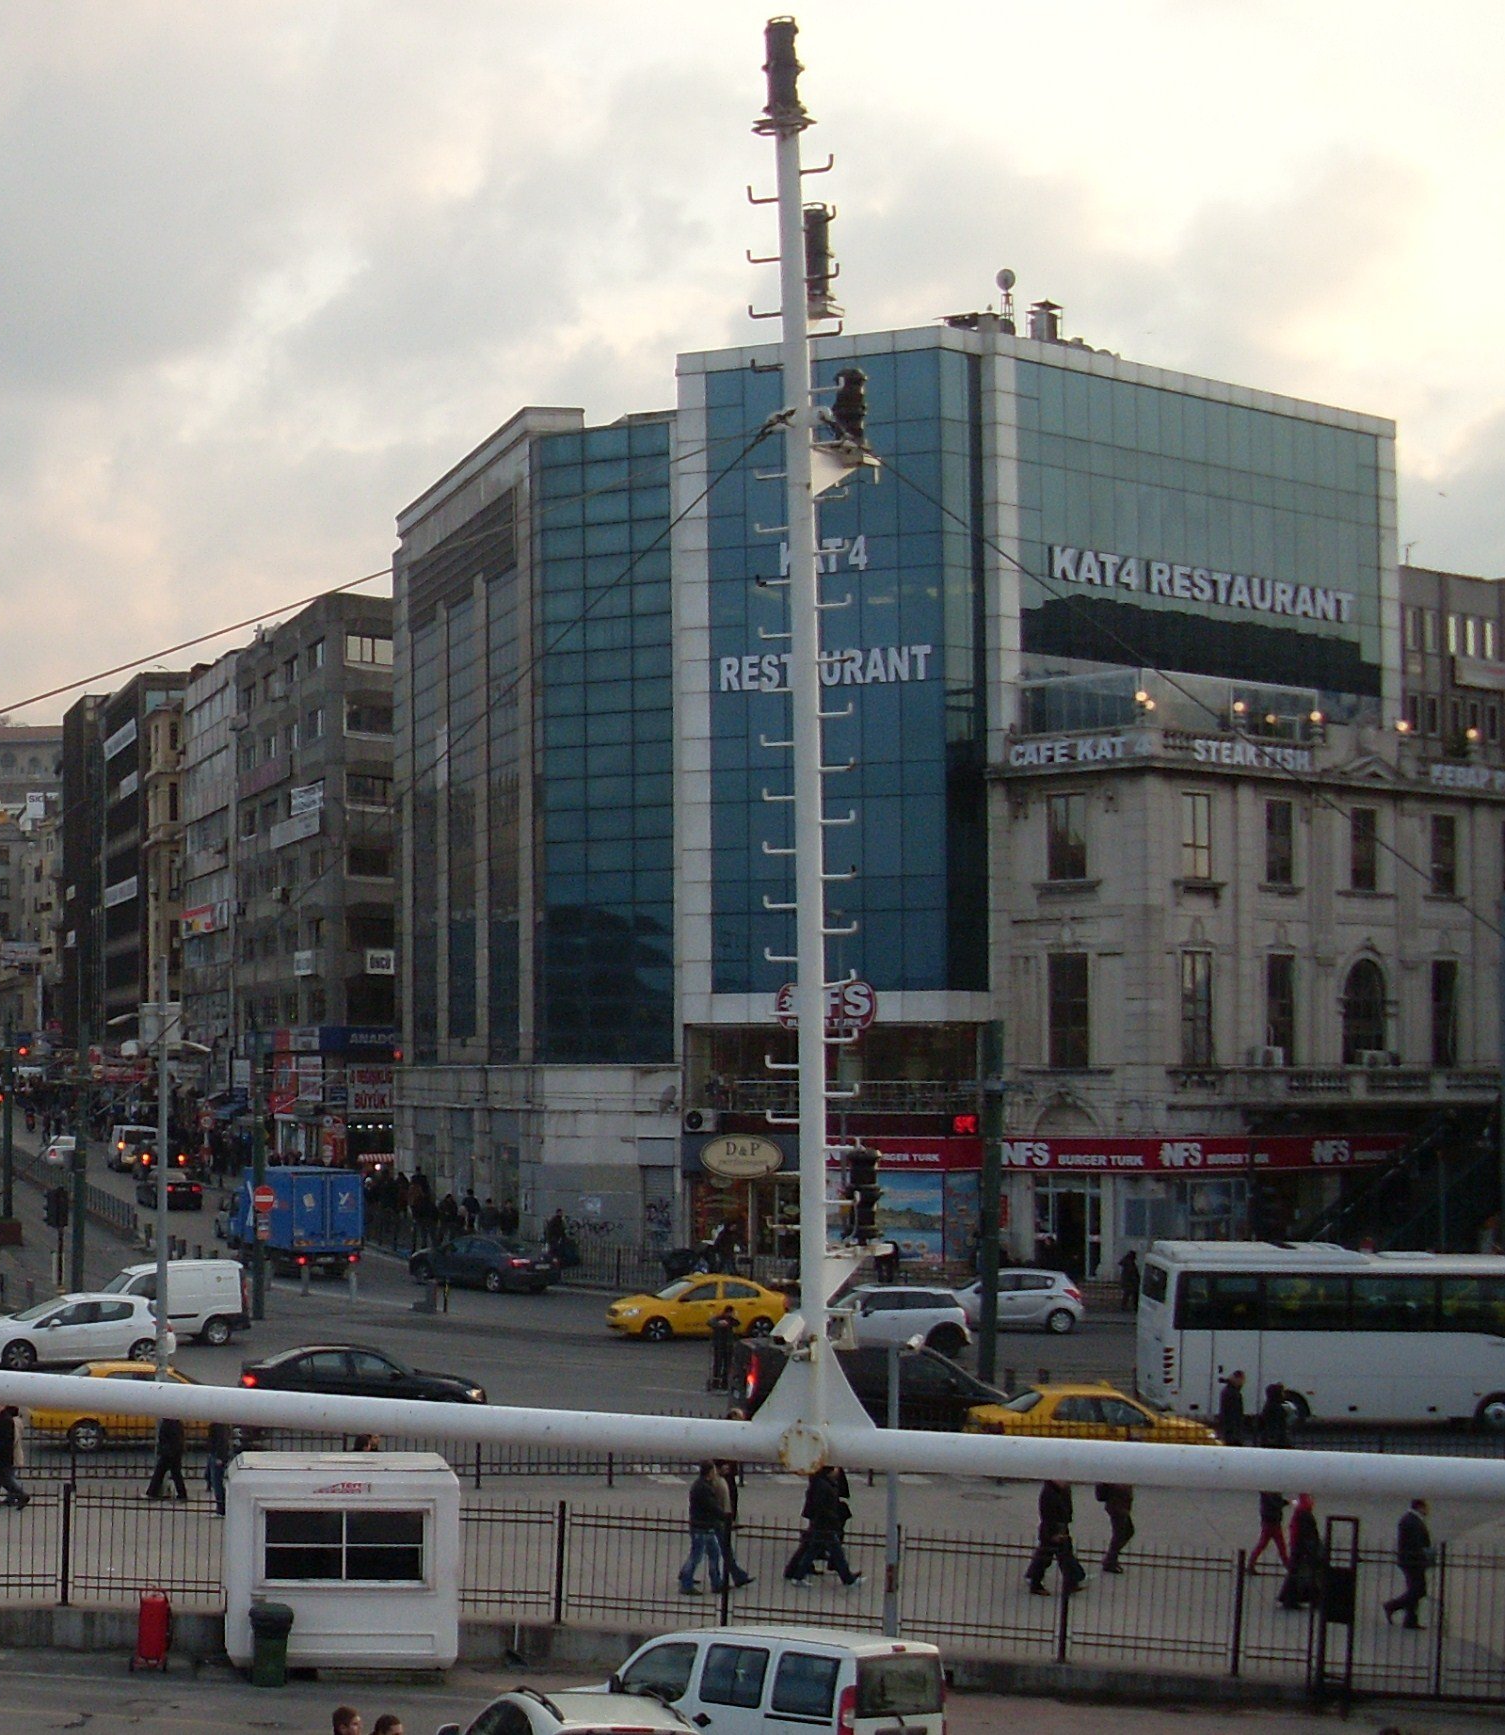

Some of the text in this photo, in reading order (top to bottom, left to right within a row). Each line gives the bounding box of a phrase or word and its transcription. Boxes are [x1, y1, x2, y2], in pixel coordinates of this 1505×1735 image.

[1149, 560, 1355, 623] RESTAURANT
[719, 644, 931, 692] RESTURANT
[1076, 731, 1127, 756] KAT
[1193, 738, 1259, 768] STEAK
[1000, 1141, 1144, 1167] NFS BURGER TURK
[1160, 1141, 1202, 1167] NFS
[1312, 1139, 1351, 1164] NFS
